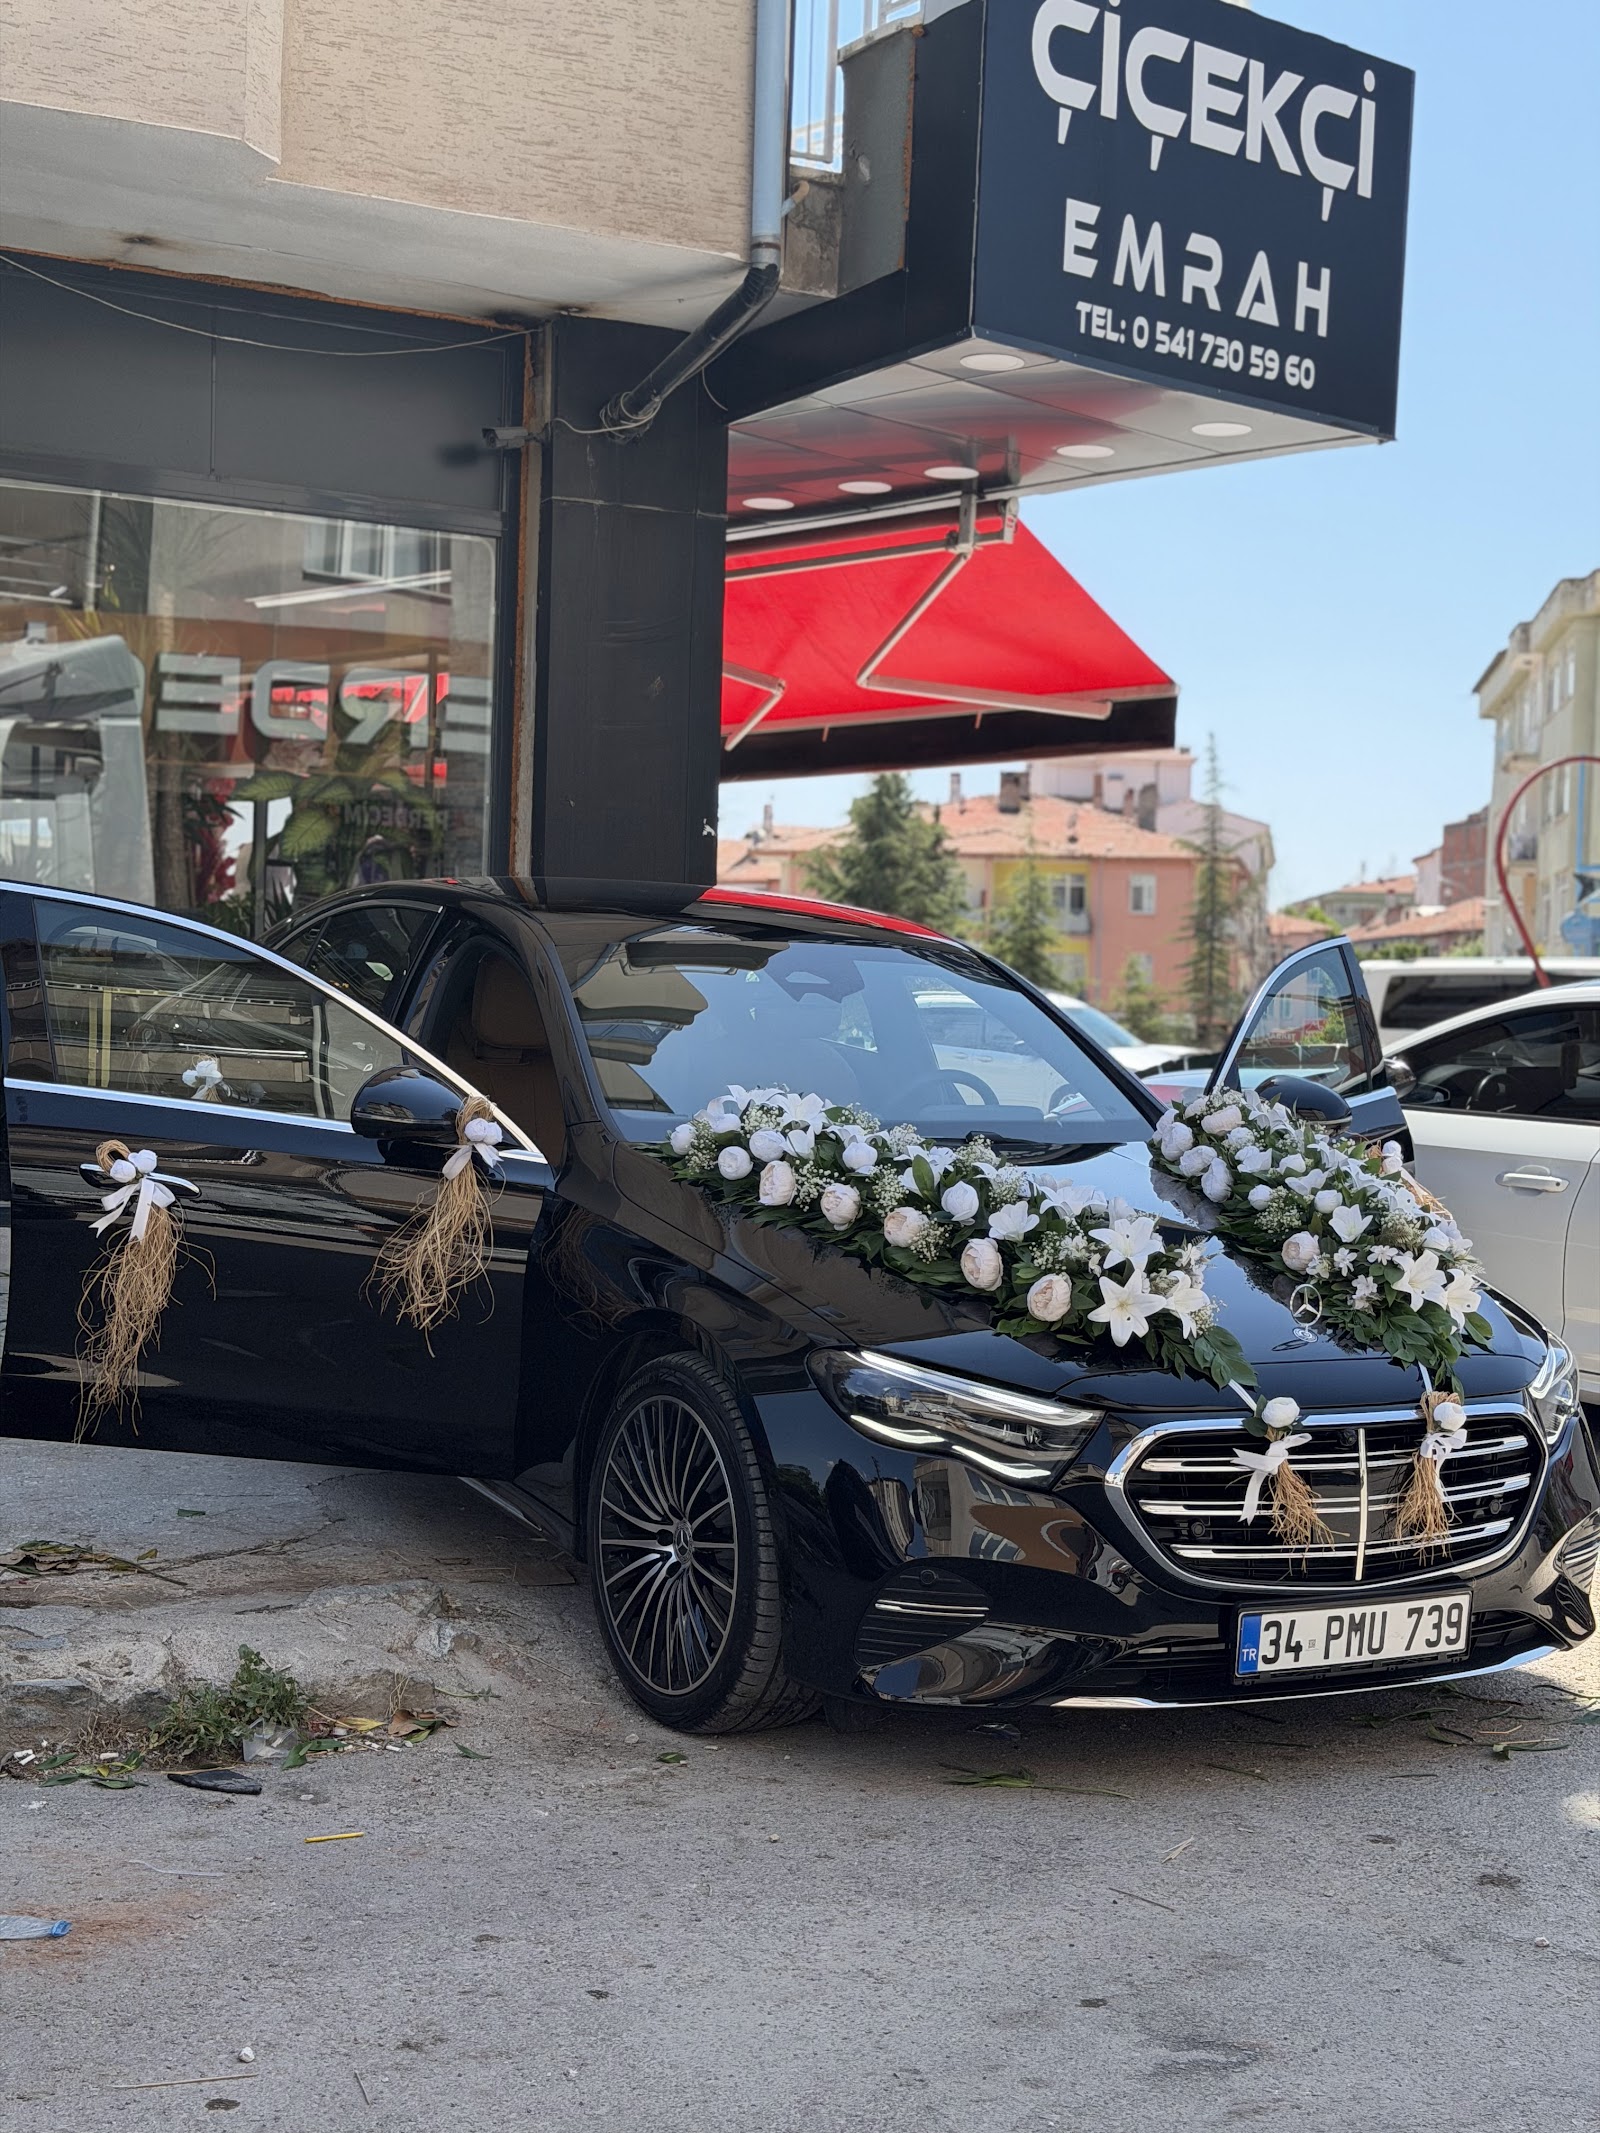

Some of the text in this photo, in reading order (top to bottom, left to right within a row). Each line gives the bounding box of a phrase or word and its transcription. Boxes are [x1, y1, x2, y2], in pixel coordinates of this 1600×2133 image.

[1031, 0, 1376, 222] ÇİÇEKÇİ
[1063, 198, 1331, 338] EMRAH
[1075, 301, 1315, 389] TEL: 0 541 730 59 60
[1242, 1648, 1257, 1662] TR
[1261, 1602, 1463, 1665] 34 PMU 739
